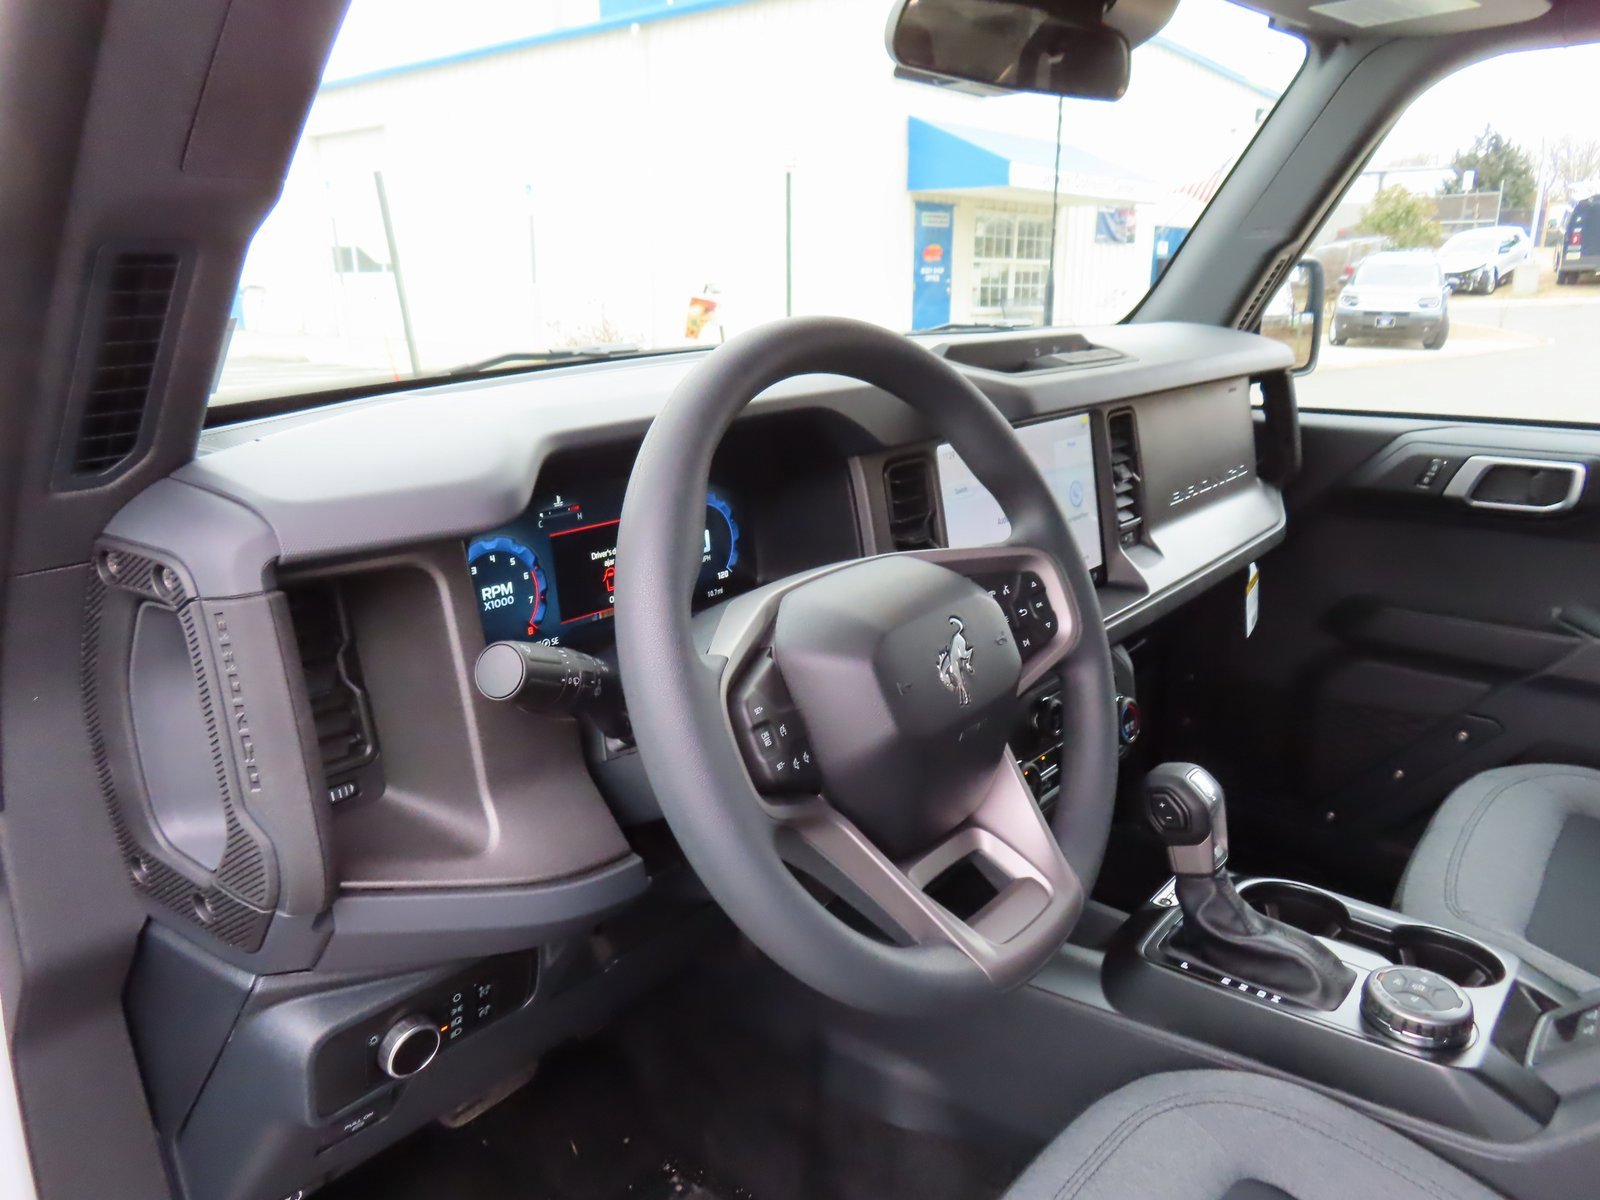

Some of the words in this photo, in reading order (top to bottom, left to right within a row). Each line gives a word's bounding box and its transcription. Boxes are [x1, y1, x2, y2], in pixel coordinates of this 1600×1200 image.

[577, 512, 583, 520] H
[538, 520, 543, 528] C
[489, 554, 496, 563] 4
[509, 557, 516, 566] 5
[470, 566, 477, 575] 3
[717, 570, 729, 580] 120
[523, 571, 529, 580] 6
[481, 581, 513, 601] RPM
[528, 595, 533, 604] 7
[528, 626, 534, 635] 8
[550, 637, 560, 646] SE
[213, 611, 261, 793] BRONCO
